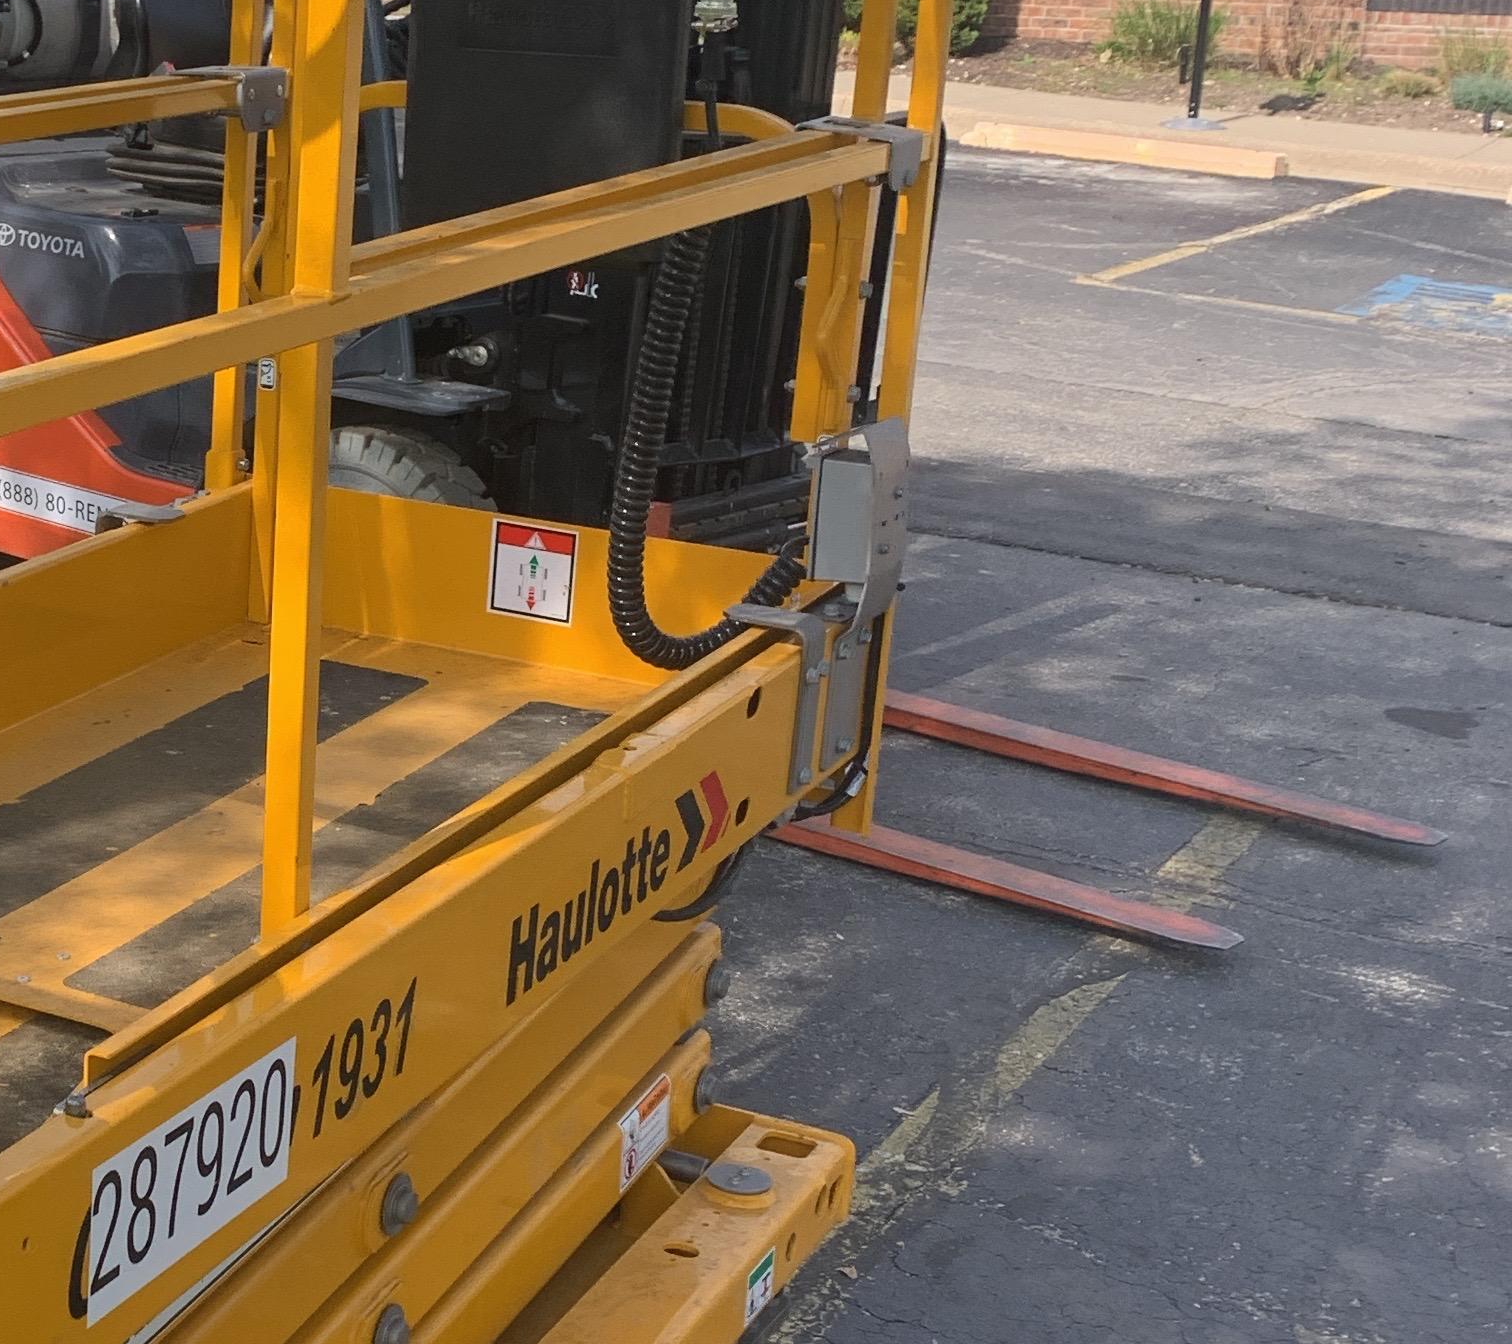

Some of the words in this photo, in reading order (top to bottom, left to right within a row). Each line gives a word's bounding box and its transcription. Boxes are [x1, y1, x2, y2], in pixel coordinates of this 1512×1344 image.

[17, 229, 85, 259] TOYOTA
[506, 825, 671, 1008] Haulotte
[89, 1057, 287, 1297] 287920
[311, 975, 418, 1140] 1931
